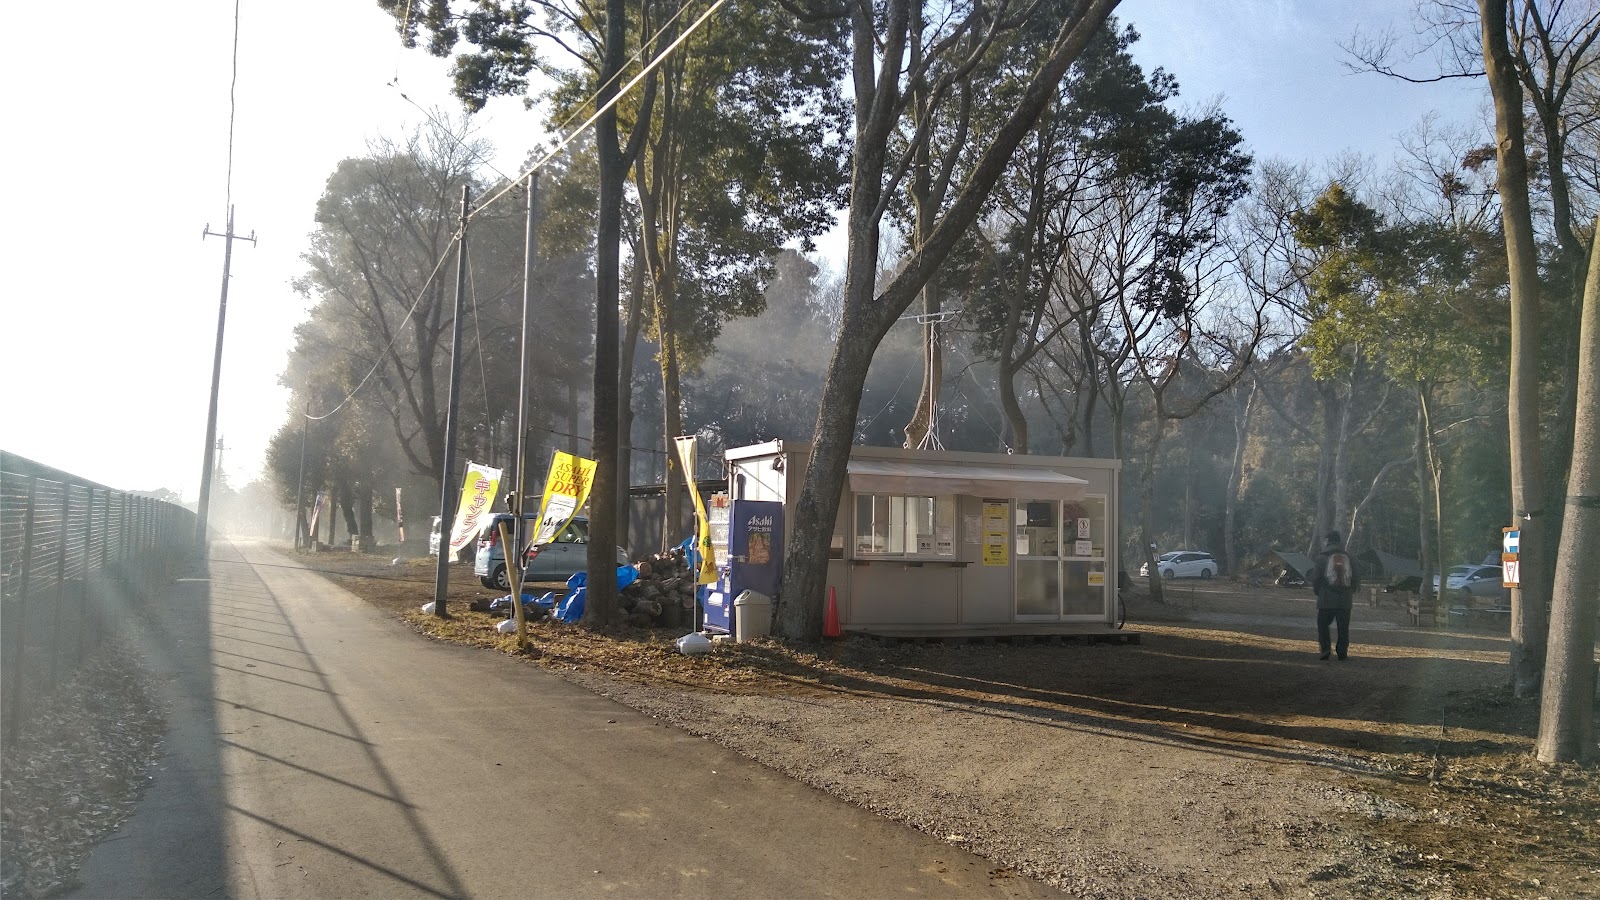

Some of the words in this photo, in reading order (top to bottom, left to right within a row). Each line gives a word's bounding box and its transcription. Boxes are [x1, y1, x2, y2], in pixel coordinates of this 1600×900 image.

[556, 462, 591, 476] ASAHI
[553, 471, 589, 486] SUPER
[551, 480, 587, 497] DRY
[748, 515, 773, 526] Asahi
